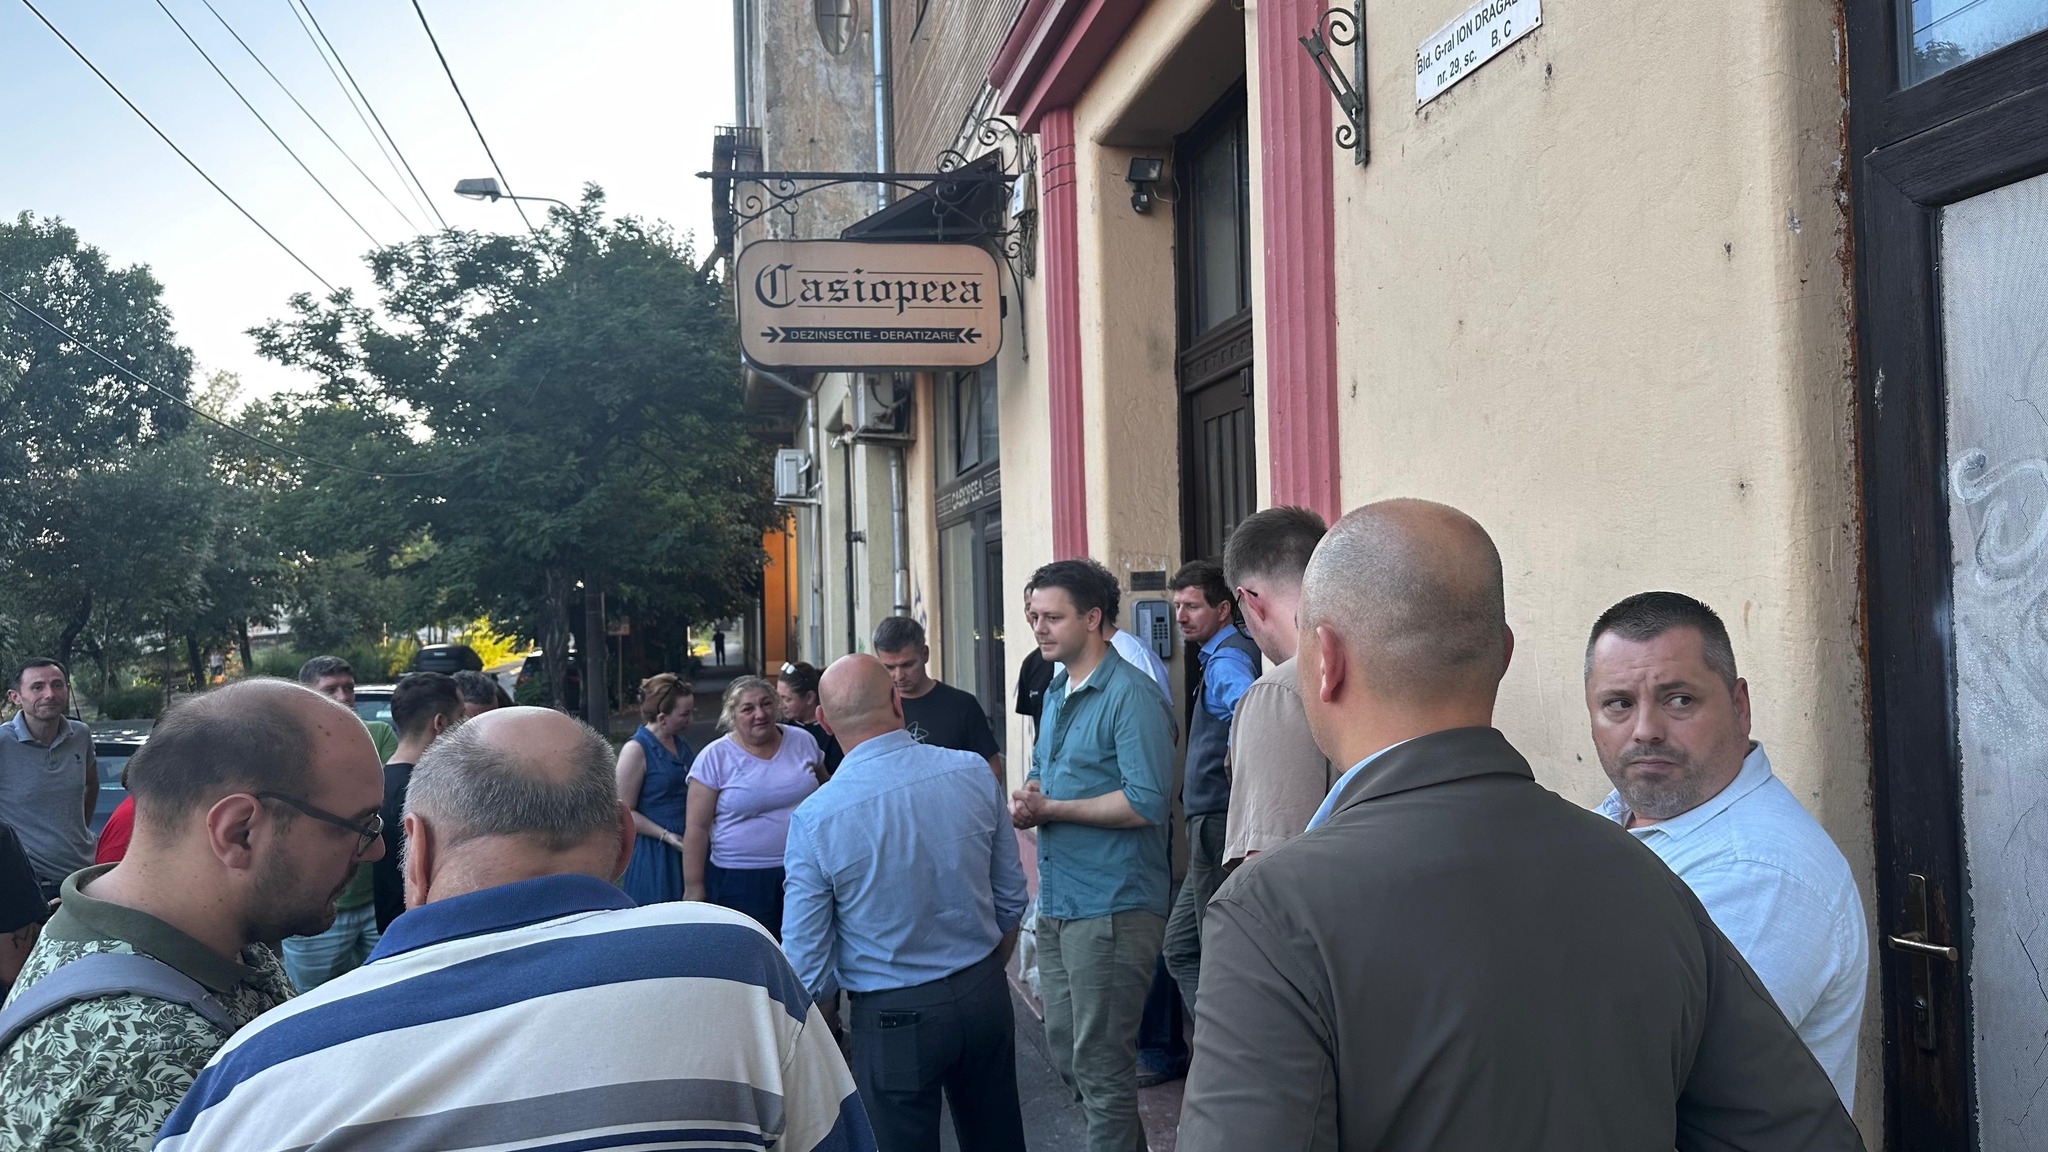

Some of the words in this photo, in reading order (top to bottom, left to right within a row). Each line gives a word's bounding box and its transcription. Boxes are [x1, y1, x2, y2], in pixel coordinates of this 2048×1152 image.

[1417, 52, 1433, 76] Bld.
[1434, 34, 1455, 61] G-ral
[1456, 19, 1473, 46] ION
[1437, 71, 1448, 87] nr.
[1449, 57, 1463, 78] 29,
[1464, 50, 1477, 67] sc.
[1504, 19, 1512, 38] C
[755, 263, 983, 316] Casiopeea
[790, 330, 871, 341] DEZINSECTIE
[880, 330, 956, 341] DERATIZARE
